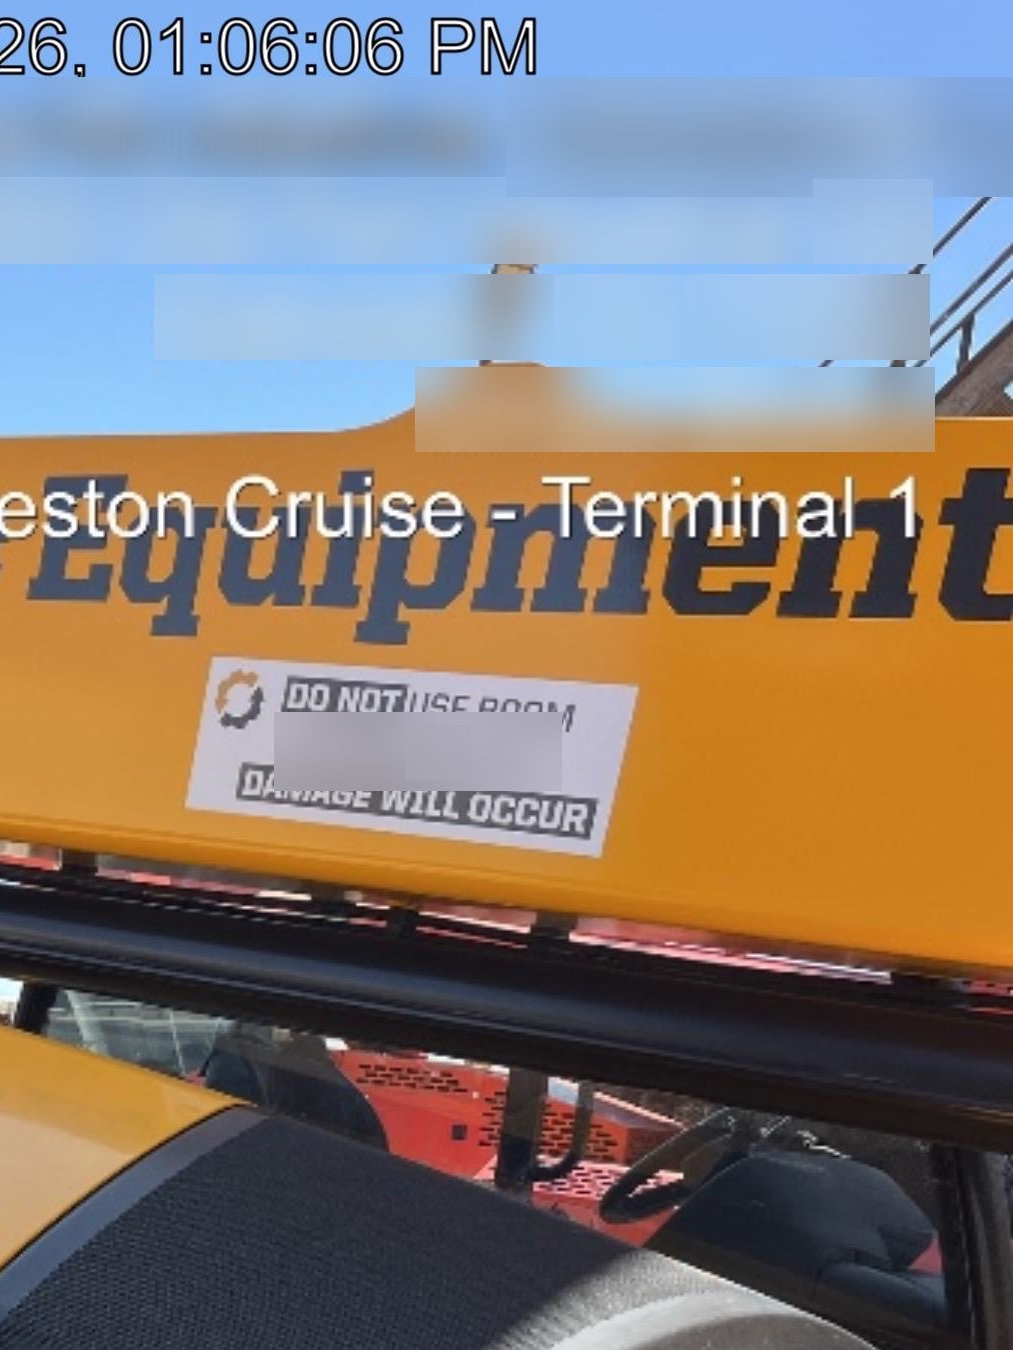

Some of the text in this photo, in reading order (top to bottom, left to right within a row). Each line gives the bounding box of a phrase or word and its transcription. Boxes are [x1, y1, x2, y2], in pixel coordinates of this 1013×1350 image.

[25, 467, 1013, 645] Equipment
[287, 682, 330, 711] DO
[338, 686, 403, 713] NOT
[381, 790, 460, 820] WILL
[468, 792, 589, 834] OCCUR
